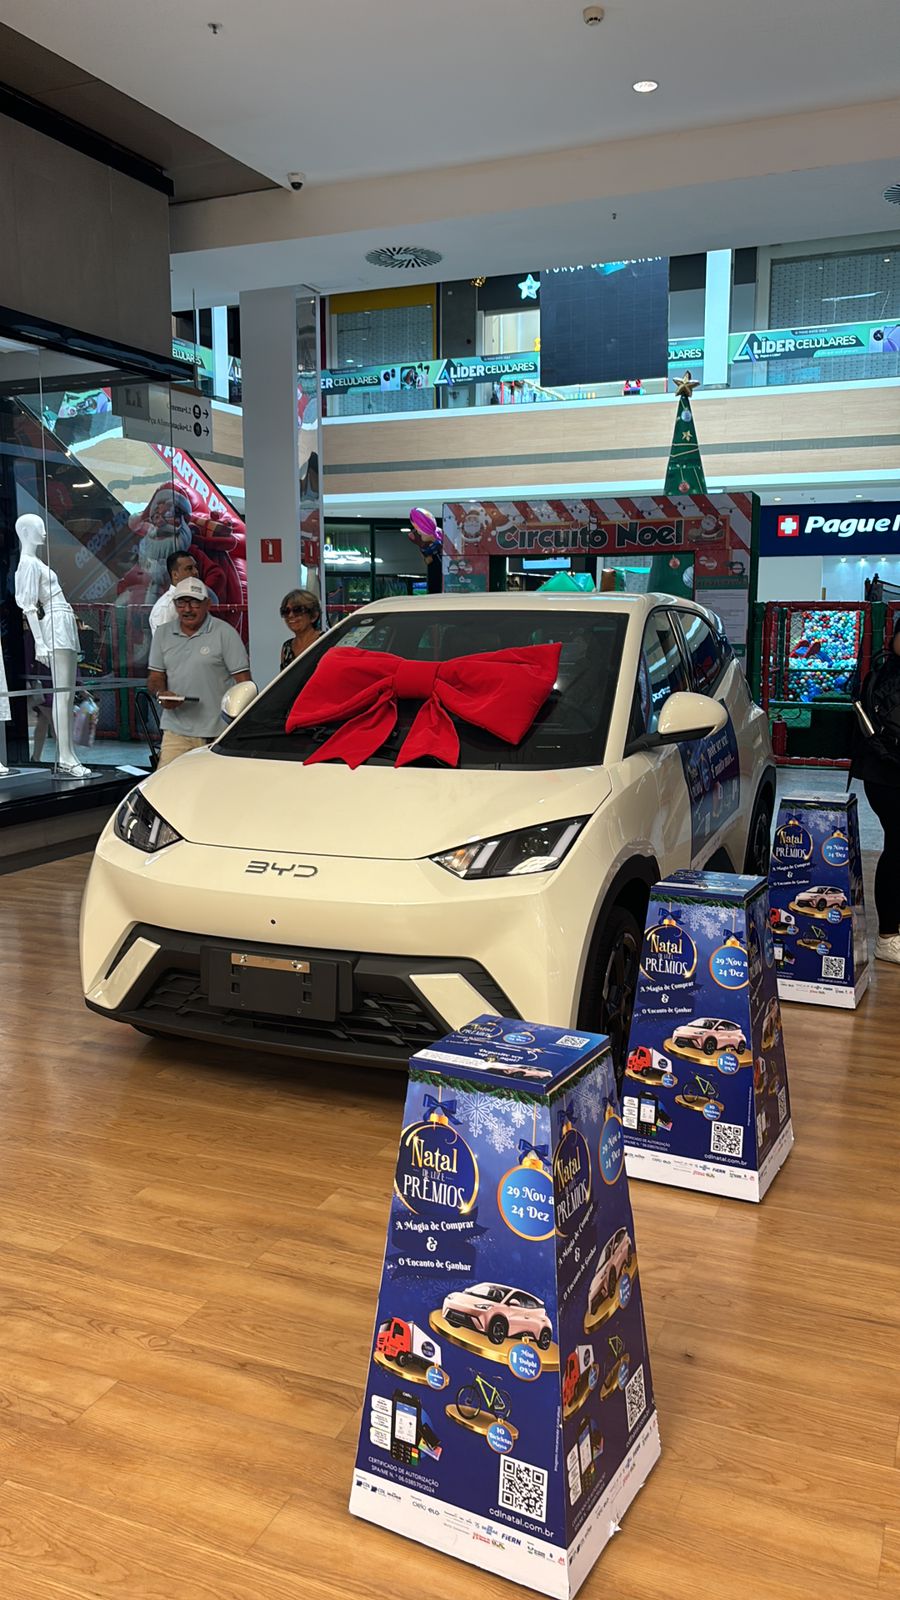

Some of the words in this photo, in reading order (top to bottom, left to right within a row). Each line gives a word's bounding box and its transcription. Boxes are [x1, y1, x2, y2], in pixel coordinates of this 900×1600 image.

[796, 336, 857, 350] CELULARES
[172, 348, 201, 365] ELULARES
[486, 362, 535, 374] CELULARES
[334, 376, 378, 387] CELULARES
[496, 521, 608, 549] Circuito
[616, 519, 684, 548] Noel
[804, 516, 891, 538] Pague
[780, 831, 803, 845] Natal
[776, 846, 806, 860] PRÊMIOS
[245, 860, 318, 878] BYD
[650, 933, 682, 955] Natal
[646, 957, 688, 976] PRÊMIOS
[726, 958, 742, 967] Nov
[719, 969, 728, 978] 24
[729, 969, 744, 978] Dez
[646, 985, 663, 993] Magia
[671, 982, 693, 990] Comprar
[661, 994, 670, 1004] &
[411, 1136, 458, 1173] Natal
[704, 1154, 748, 1166] cdlnatal.com.br
[558, 1146, 581, 1192] Natal
[404, 1174, 465, 1209] PRÊMIOS
[507, 1186, 520, 1199] 29
[522, 1187, 546, 1204] Nov
[548, 1195, 554, 1205] a
[556, 1178, 587, 1227] PRÊMIOS
[512, 1205, 524, 1218] 24
[526, 1207, 550, 1222] Dez
[396, 1220, 403, 1230] A
[404, 1220, 429, 1233] Magia
[430, 1220, 439, 1230] de
[440, 1220, 474, 1232] Comprar
[562, 1238, 575, 1258] Magia
[578, 1202, 594, 1232] Comprar
[426, 1237, 438, 1252] &
[574, 1248, 581, 1263] &
[398, 1258, 405, 1266] O
[406, 1257, 435, 1268] Encanto
[436, 1257, 444, 1269] de
[445, 1261, 472, 1272] Ganhar
[563, 1292, 568, 1301] O
[512, 1352, 517, 1364] 1
[497, 1427, 505, 1436] 10
[368, 1456, 398, 1472] CERTIFICADO
[398, 1467, 405, 1475] DE
[406, 1471, 439, 1488] AUTORIZAÇÃO
[489, 1508, 555, 1538] cdlnatal.com.br
